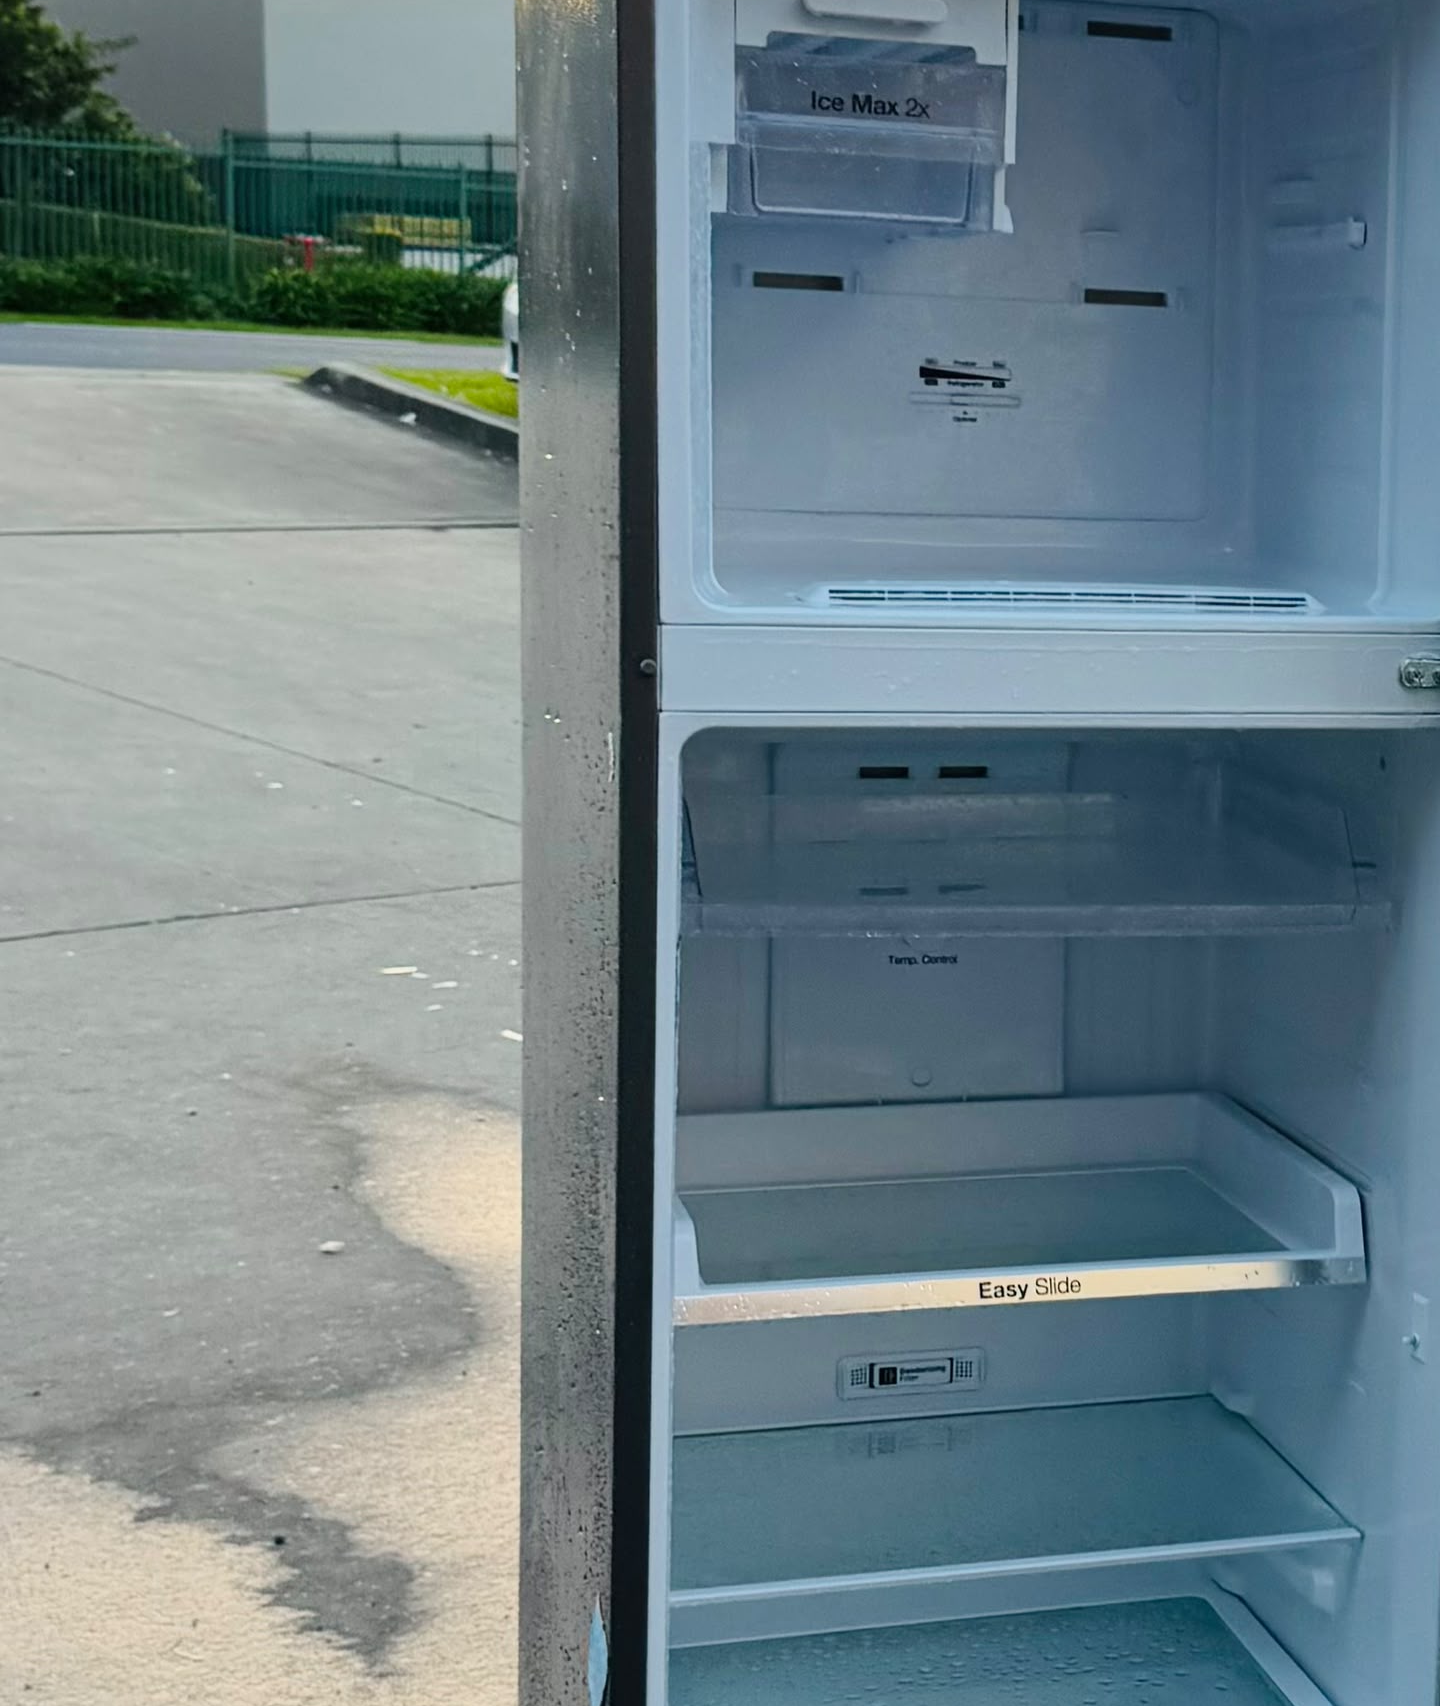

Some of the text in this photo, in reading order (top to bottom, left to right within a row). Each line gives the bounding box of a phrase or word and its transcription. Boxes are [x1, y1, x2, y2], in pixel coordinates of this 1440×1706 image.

[811, 90, 930, 119] Ice Max 2x
[922, 953, 958, 965] Control
[979, 1276, 1081, 1300] Easy Slide
